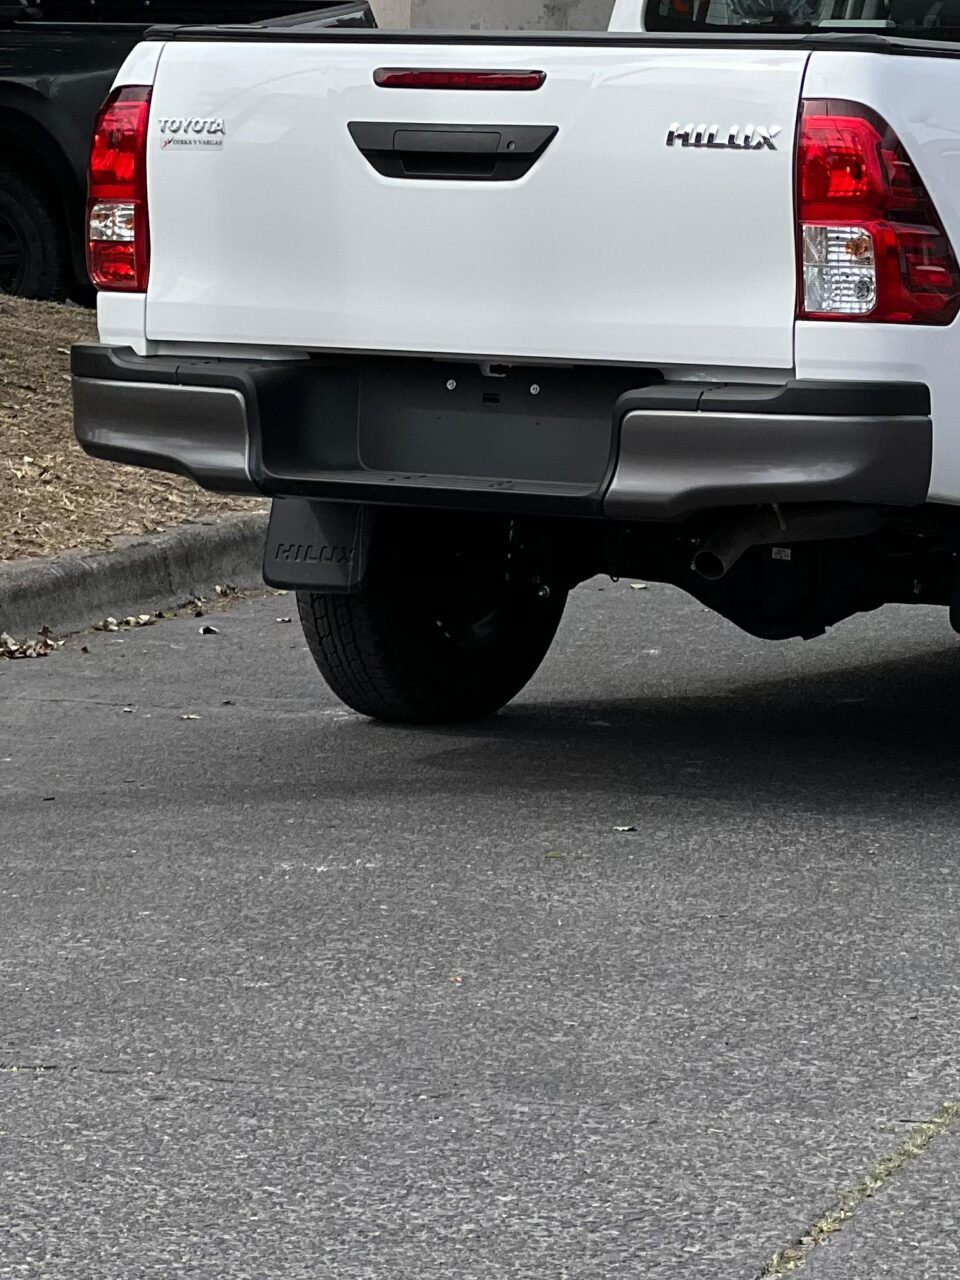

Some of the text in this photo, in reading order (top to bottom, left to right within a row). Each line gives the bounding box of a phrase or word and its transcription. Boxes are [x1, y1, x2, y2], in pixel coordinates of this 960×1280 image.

[158, 118, 226, 135] TOYOTA
[665, 122, 782, 150] HILUX
[274, 543, 356, 563] HILUX
